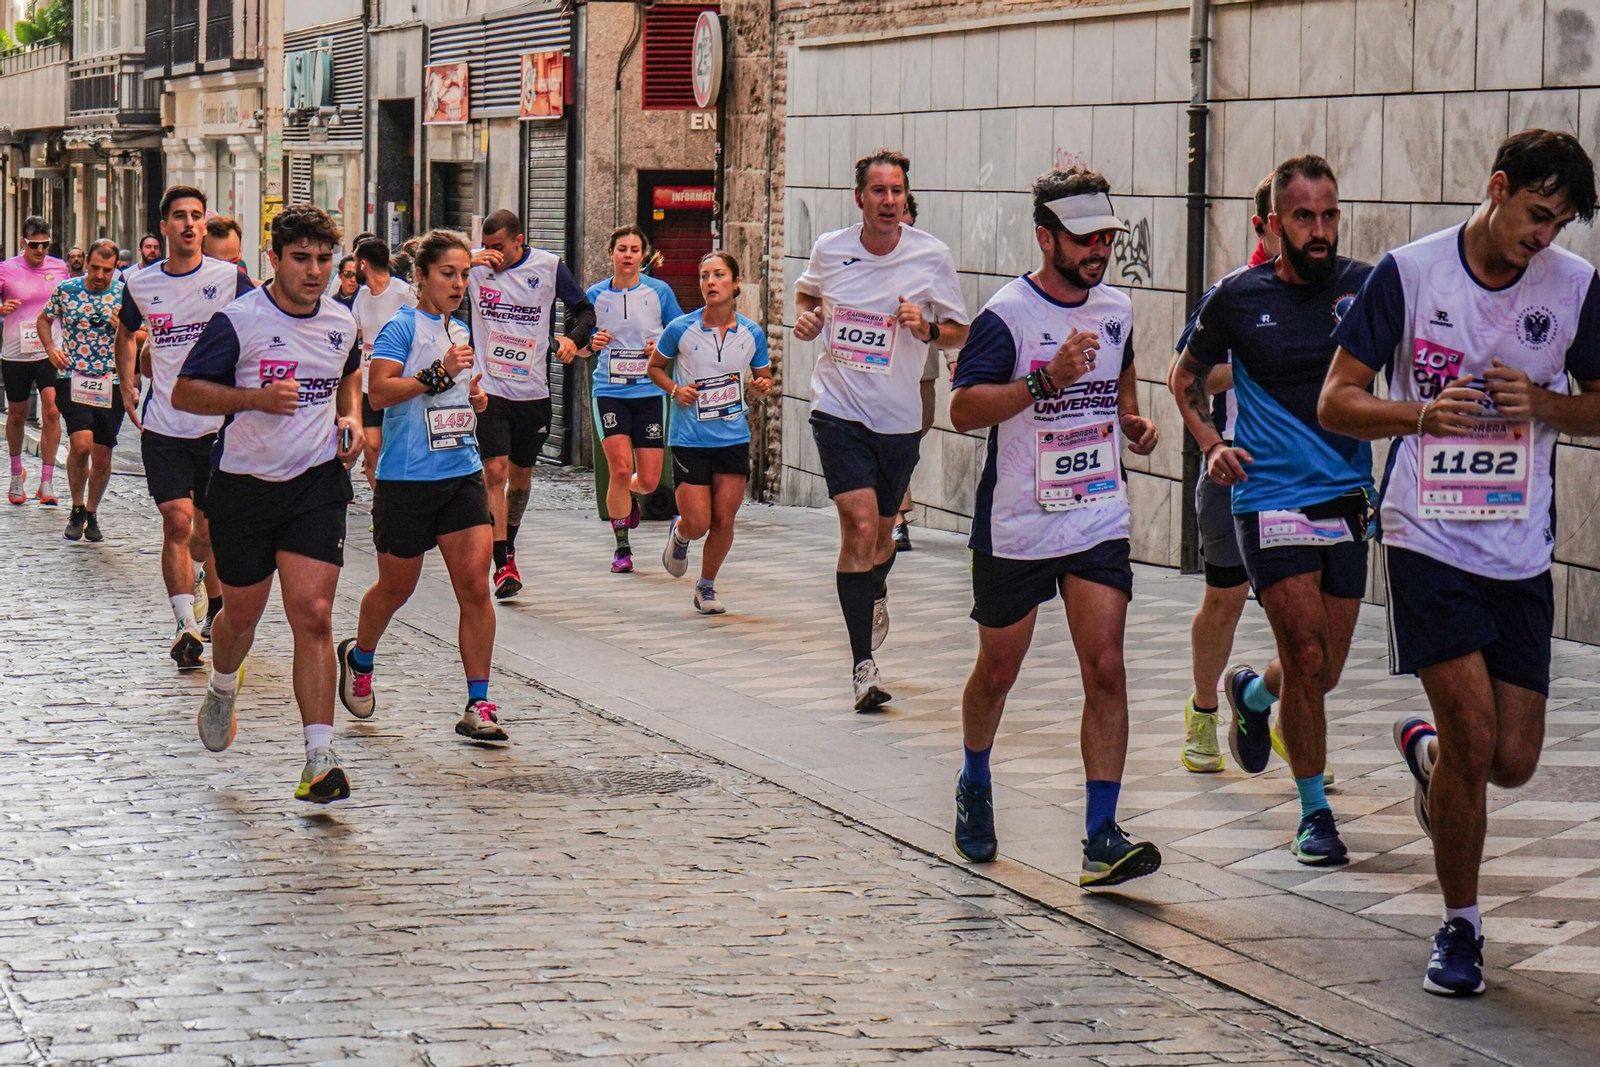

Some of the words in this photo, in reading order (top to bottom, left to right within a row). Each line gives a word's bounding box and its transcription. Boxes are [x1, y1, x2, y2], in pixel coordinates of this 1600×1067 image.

[479, 300, 542, 315] CARRERA
[481, 308, 540, 322] UNIVERSIDAD
[847, 311, 884, 322] CARRERA
[837, 326, 887, 347] 1031
[493, 346, 527, 361] 860
[1414, 347, 1461, 371] 10ª
[616, 361, 647, 372] 632
[80, 380, 103, 391] 421
[434, 412, 473, 430] 1457
[1057, 428, 1098, 442] CARRERA
[1055, 449, 1101, 475] 981
[1430, 450, 1518, 475] 1182
